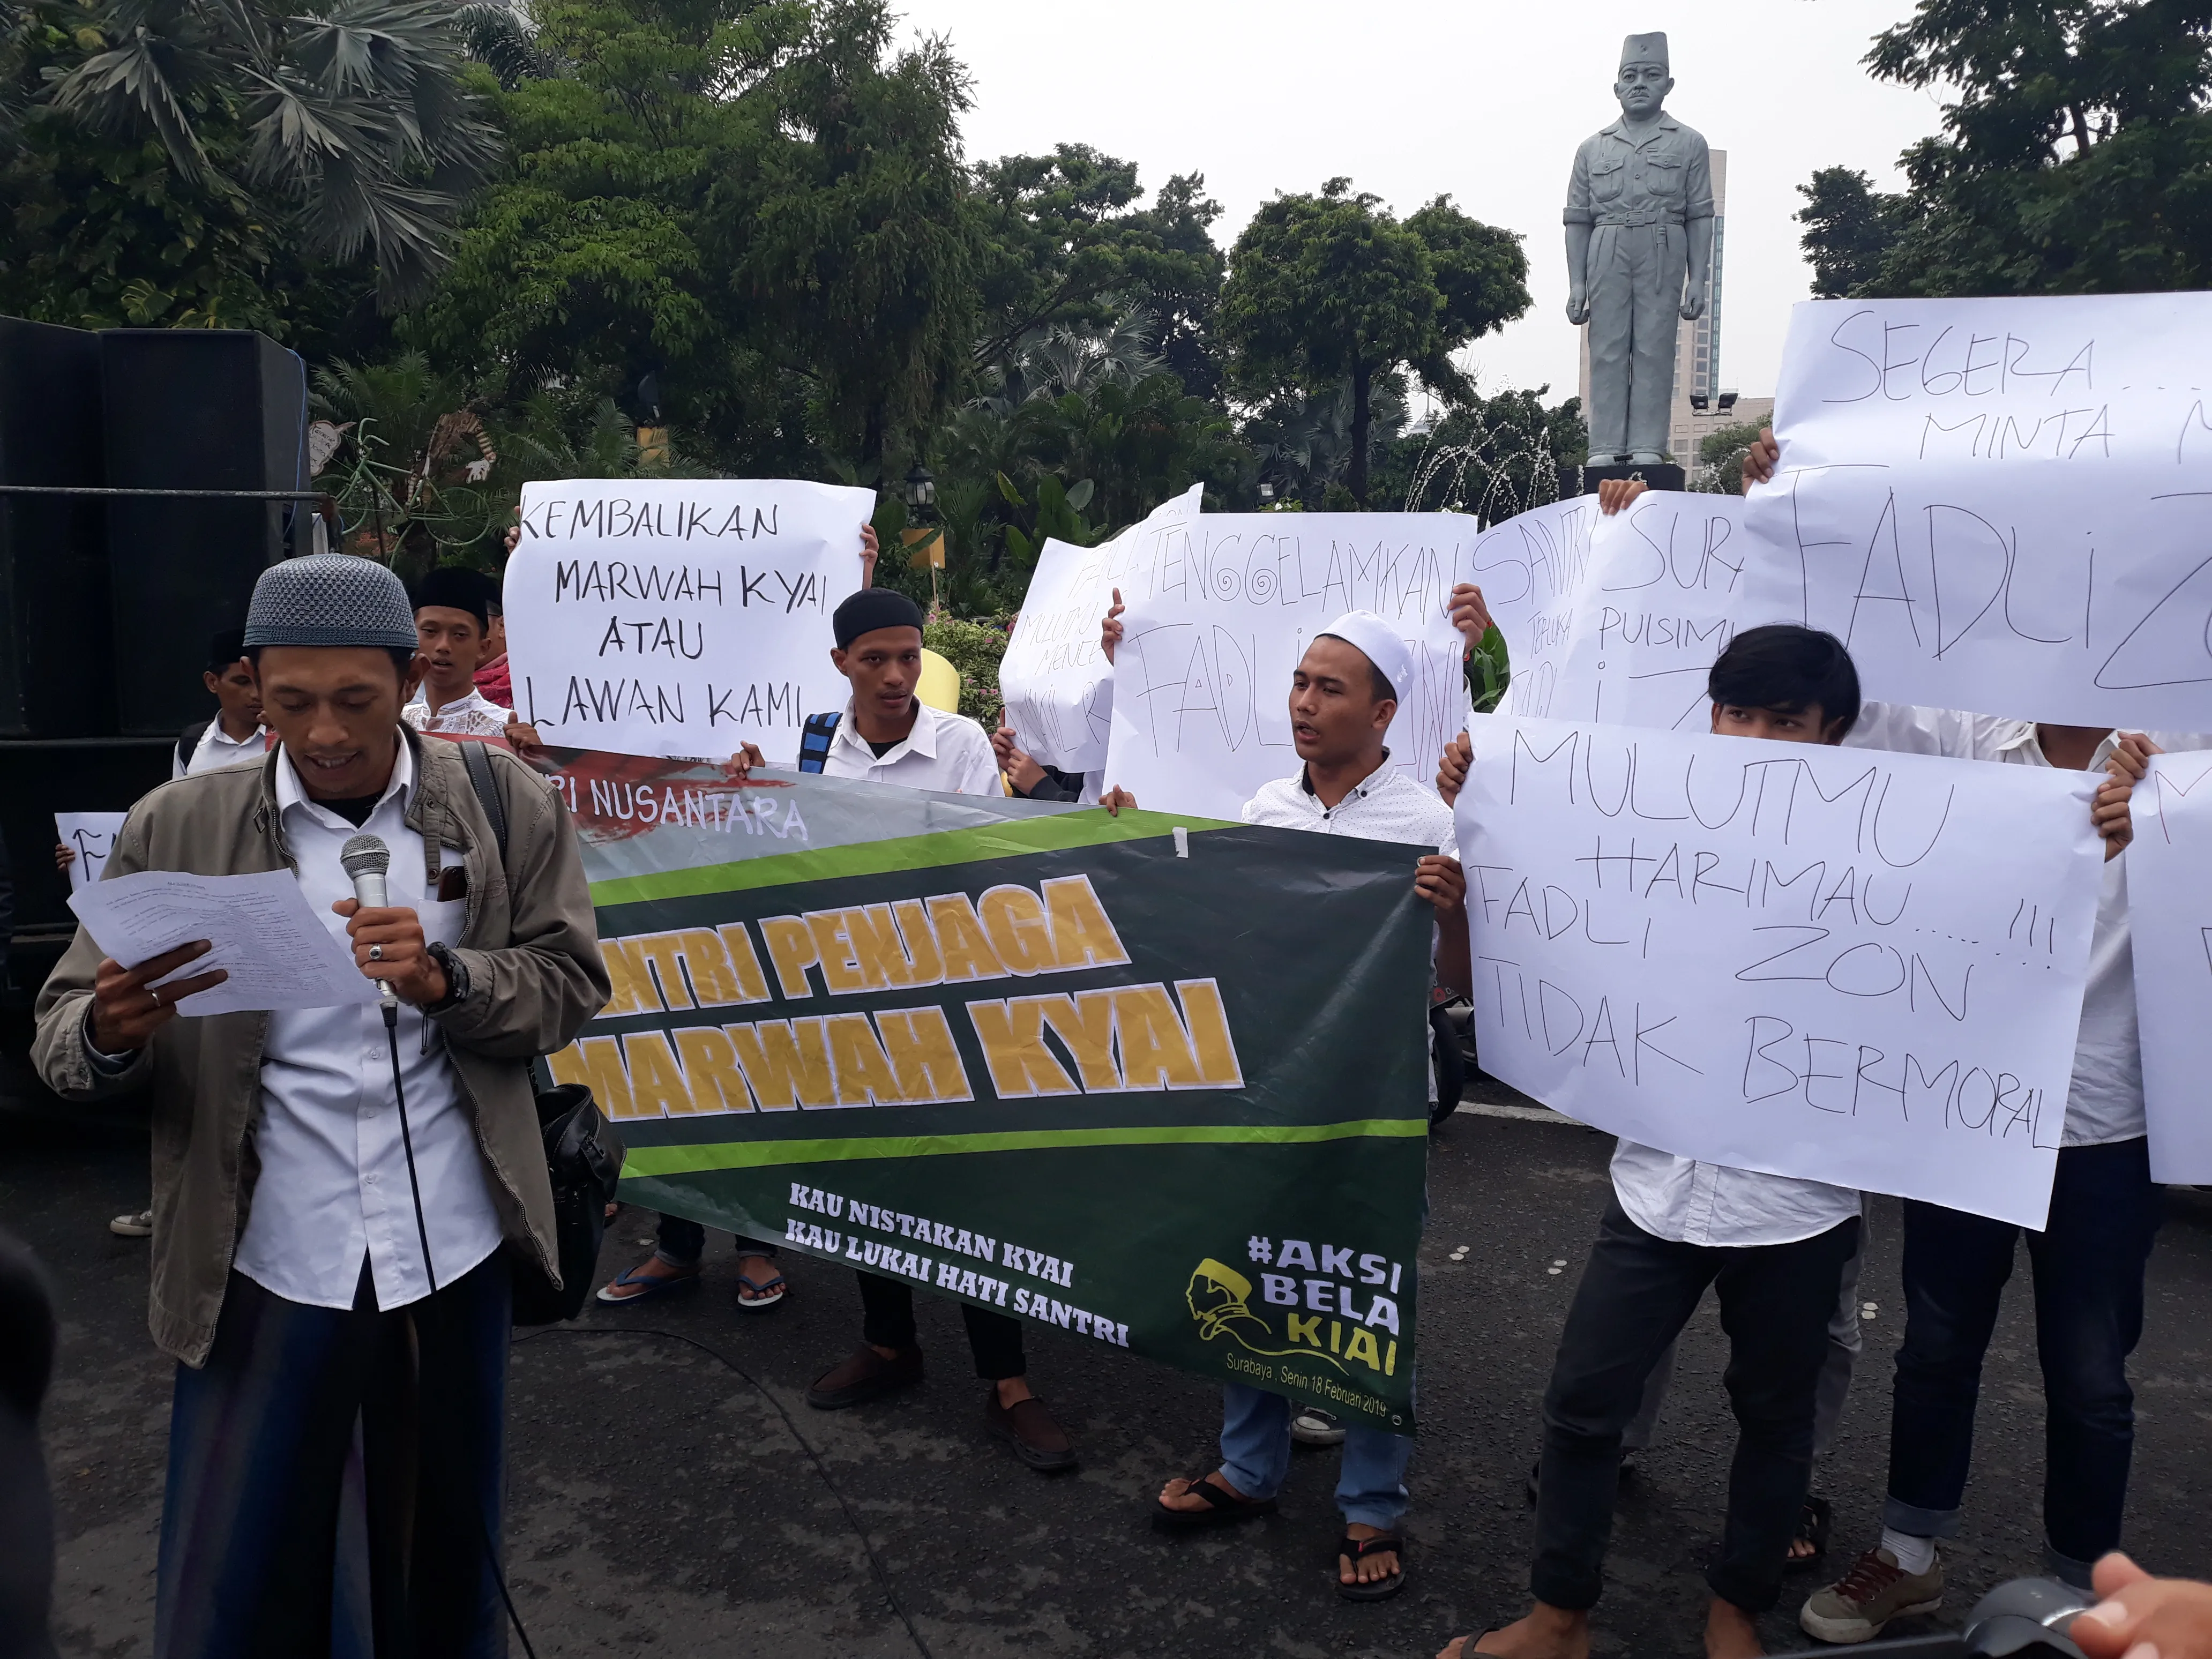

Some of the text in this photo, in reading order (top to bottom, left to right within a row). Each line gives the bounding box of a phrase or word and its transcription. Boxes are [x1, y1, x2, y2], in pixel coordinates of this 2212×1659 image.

[1920, 403, 2116, 460] MINTA
[519, 494, 779, 541] KEMBALIKAN
[555, 559, 827, 616] MARWAH KYAI
[1150, 522, 1459, 625] TENGGELAMKAN
[598, 615, 704, 660] ATAU
[526, 676, 802, 728] LAWAN KAMI
[589, 779, 809, 841] NUSANTARA
[1511, 729, 1954, 868] MULUTMU
[591, 873, 1133, 1020] NTRI PENJAGA
[1735, 926, 1974, 1021] ZON
[544, 977, 1246, 1123] MARWAH KYAI
[1478, 956, 2060, 1150] TIDAK BERMORAL
[789, 1182, 1074, 1288] KAU NISTAKAN KYAI
[1247, 1235, 1402, 1295] #AKSI
[784, 1218, 1130, 1349] KAU LUKAI HATI SANTRI
[1260, 1272, 1400, 1337] BELA
[1287, 1311, 1398, 1377] KIAI
[1226, 1351, 1273, 1380] Surabaya
[1280, 1366, 1308, 1391] Senin
[1311, 1376, 1322, 1394] 18
[1324, 1379, 1362, 1410] Februari
[1363, 1395, 1387, 1418] 2019
